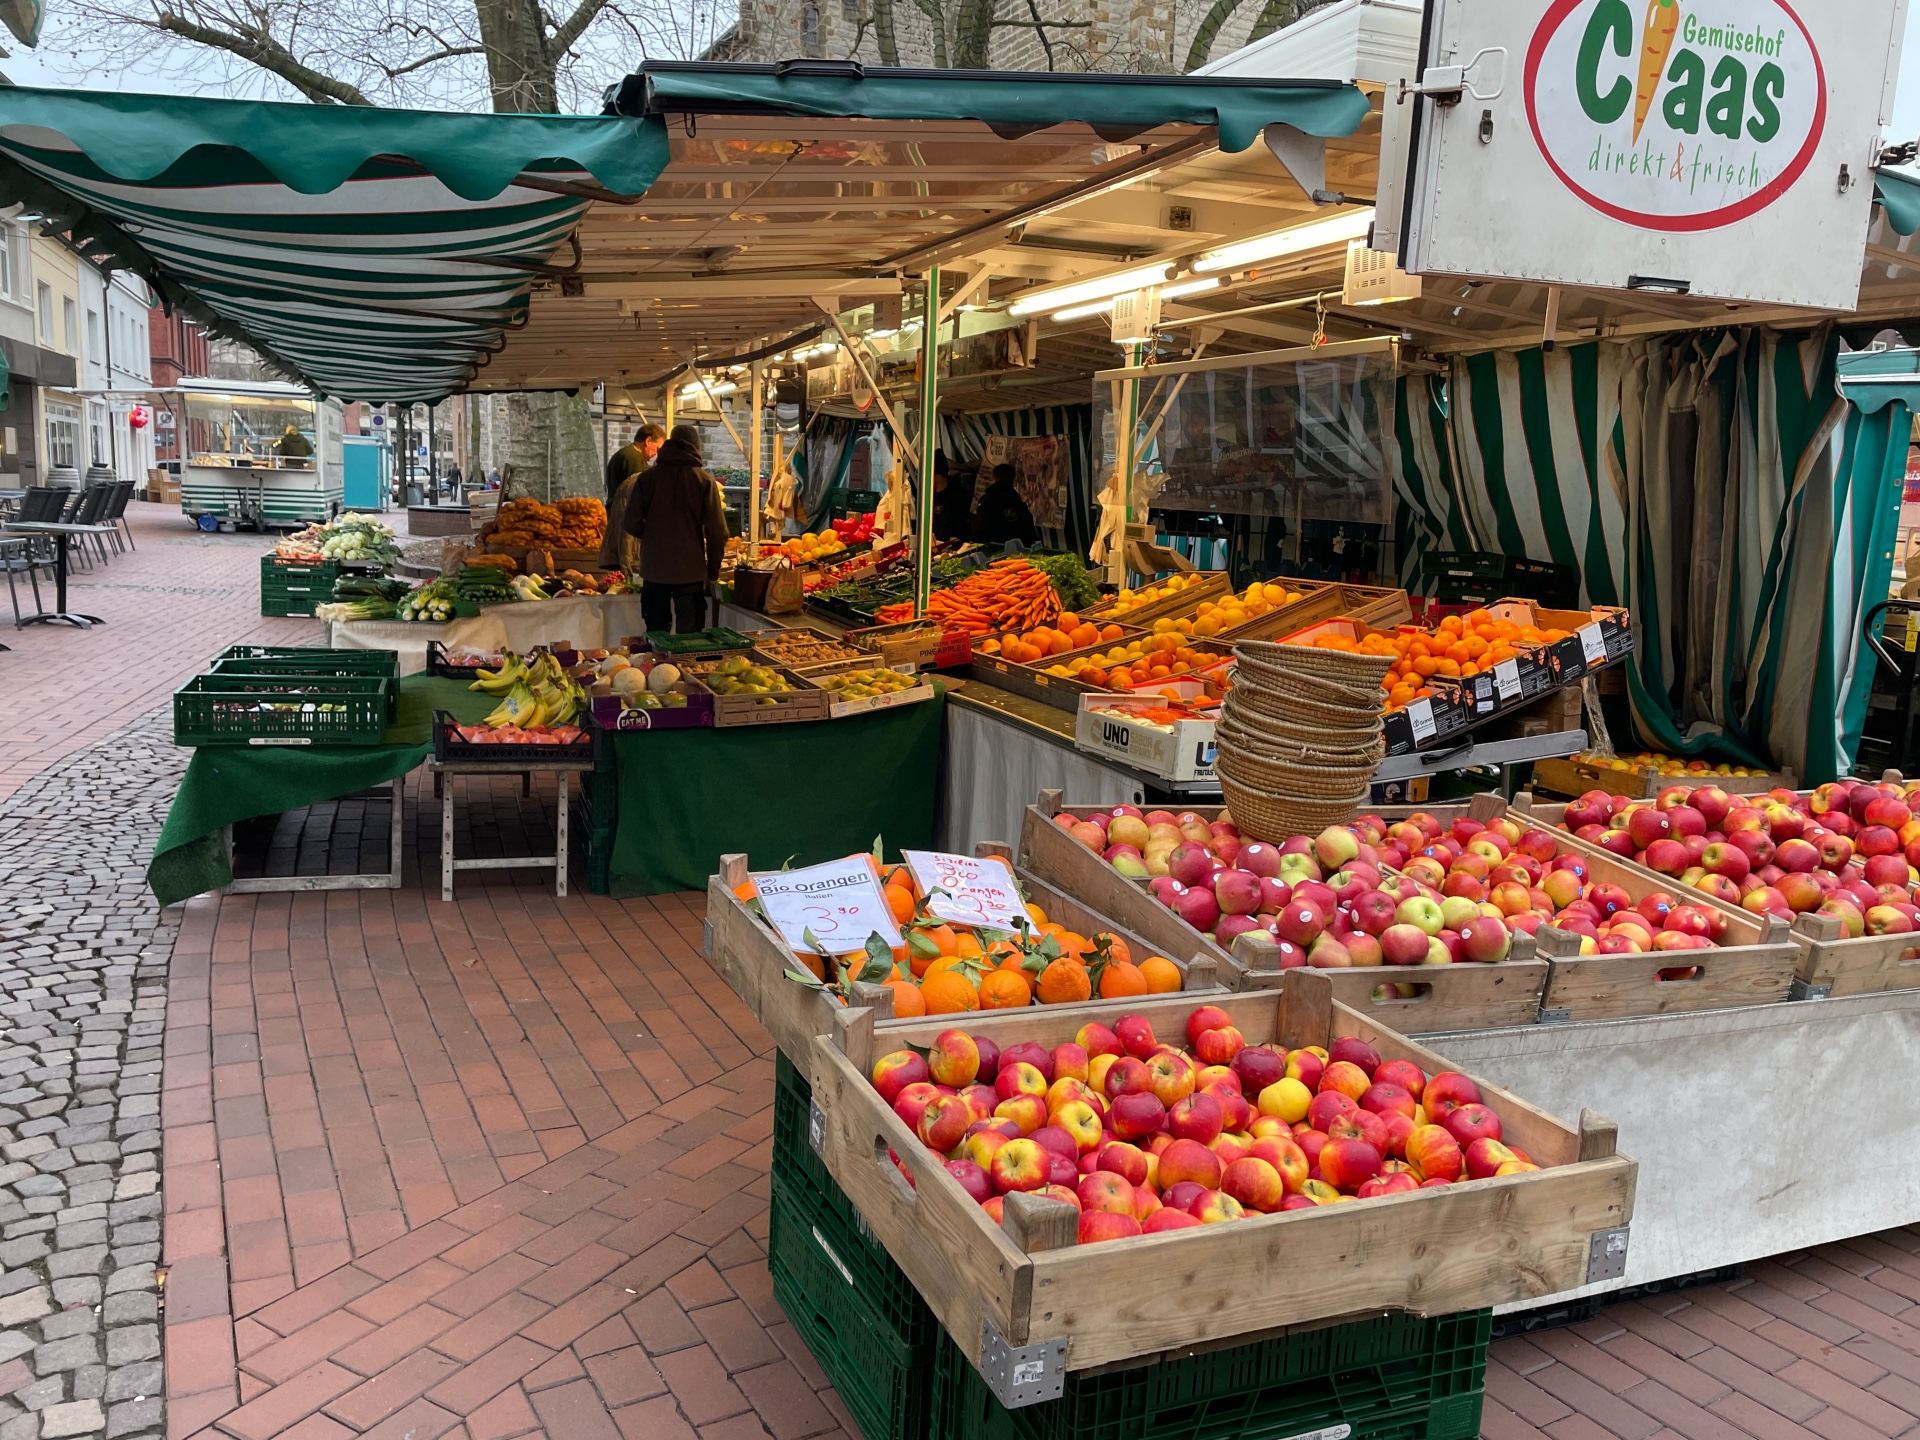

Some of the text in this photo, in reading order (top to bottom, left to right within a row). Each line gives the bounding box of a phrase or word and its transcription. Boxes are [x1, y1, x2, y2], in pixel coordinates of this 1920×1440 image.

[1683, 13, 1785, 57] Gemüsehof
[919, 644, 967, 657] PINEAPPLES
[621, 716, 647, 727] EAT ME
[1103, 722, 1129, 746] UNO
[760, 871, 869, 895] Bio Orangen
